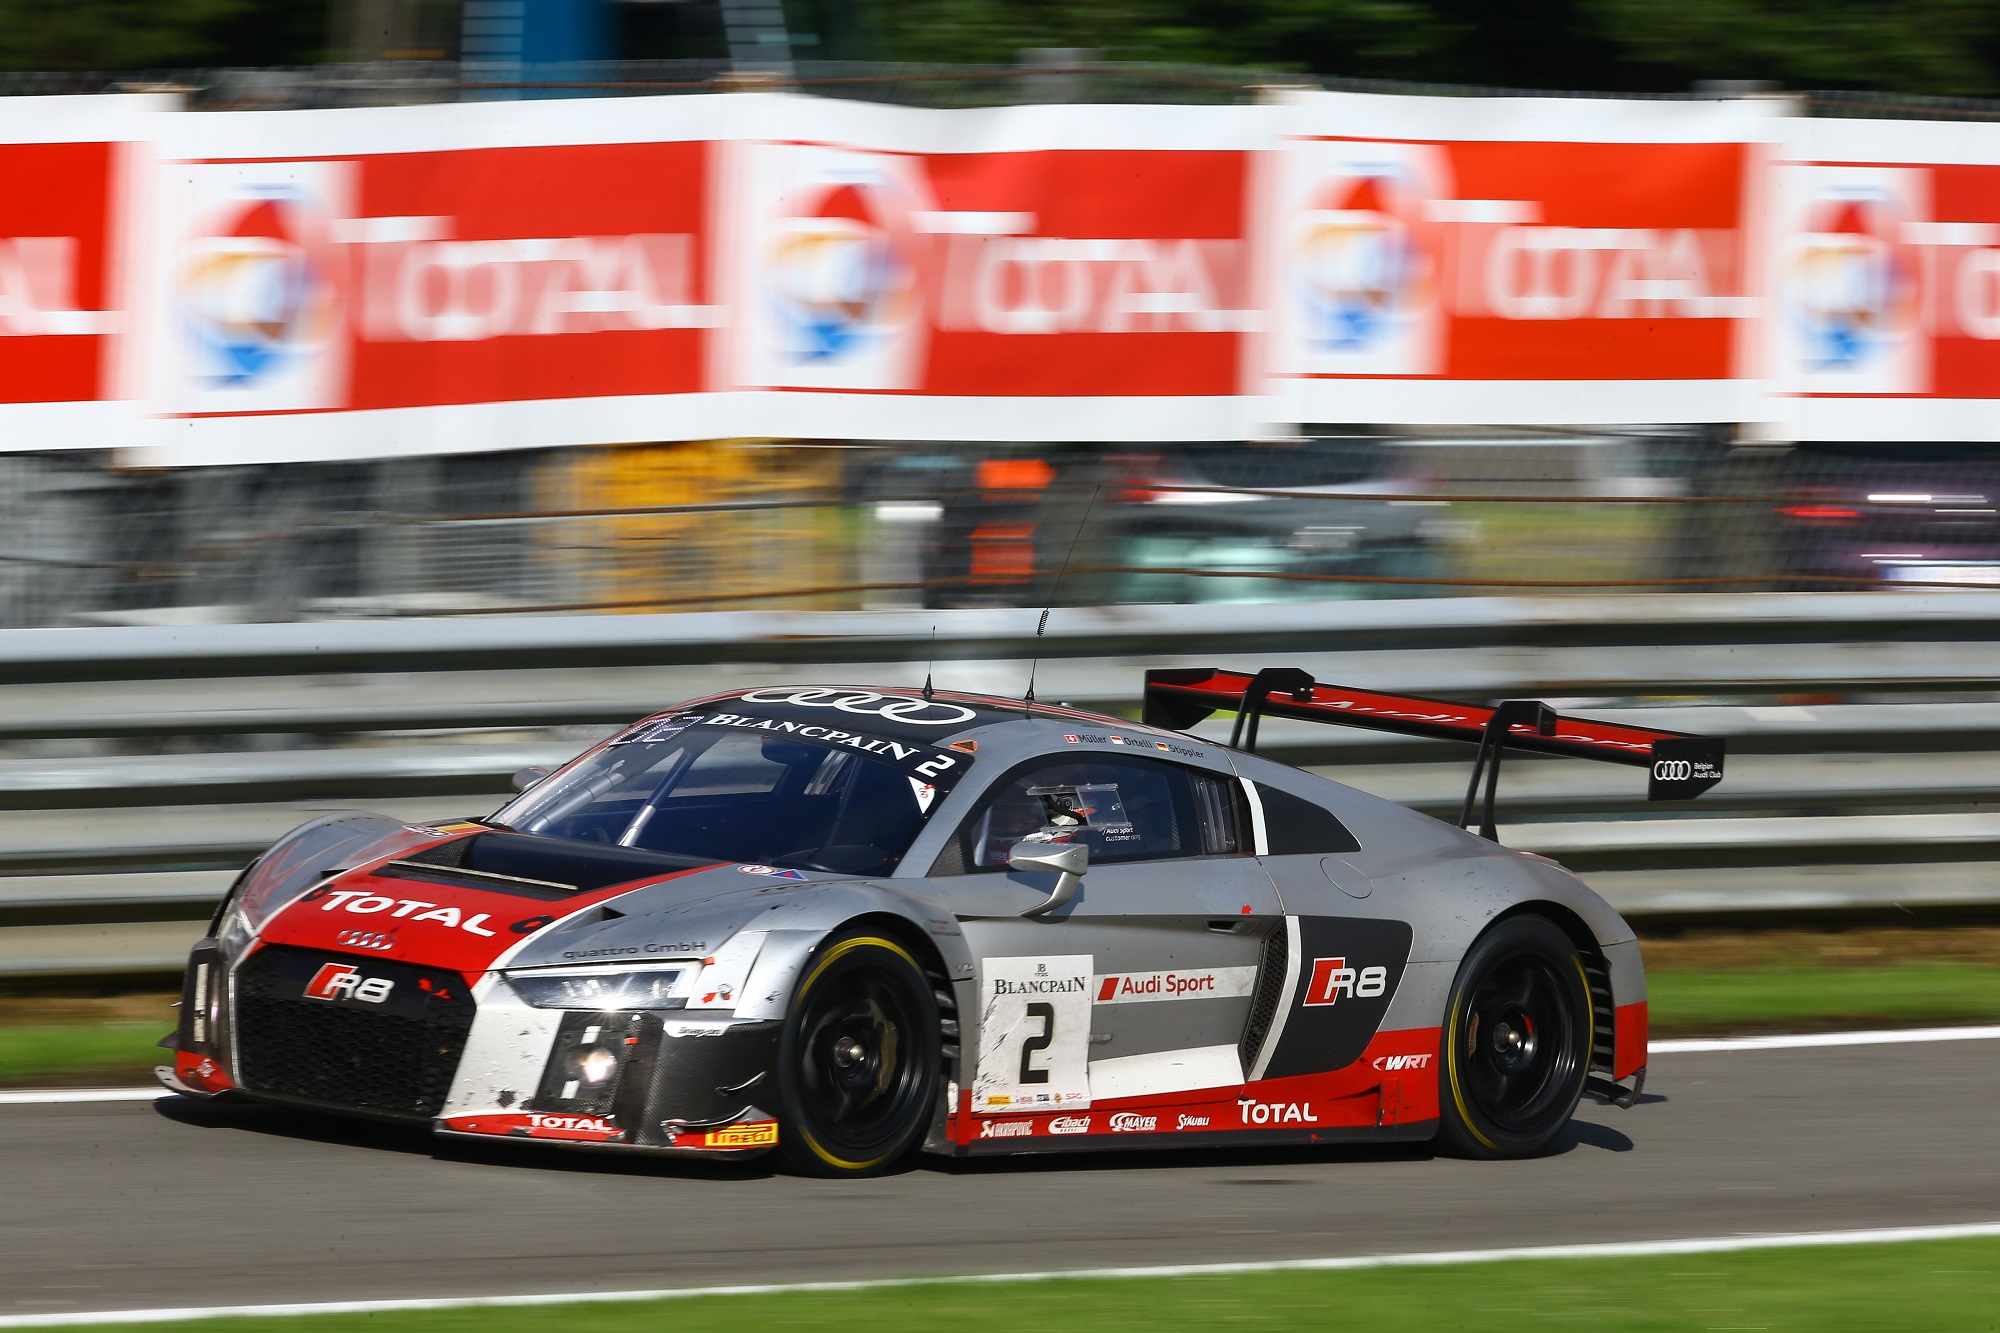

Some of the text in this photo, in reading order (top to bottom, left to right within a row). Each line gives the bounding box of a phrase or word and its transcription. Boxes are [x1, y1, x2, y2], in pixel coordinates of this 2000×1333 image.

[701, 713, 956, 778] BLANCPAIN 2
[1078, 734, 1205, 758] Müller Ortelli Stippler
[320, 890, 497, 938] TOTAL
[562, 940, 707, 960] quattro GmbH
[320, 971, 395, 1004] R8
[993, 976, 1086, 995] BLANCPAIN
[1121, 974, 1215, 997] Audi Sport
[1321, 964, 1387, 1000] R8
[1019, 1001, 1055, 1085] 2
[1385, 1053, 1433, 1070] WRT
[526, 1114, 613, 1131] TOTAL
[1122, 1116, 1157, 1128] MAYER
[1237, 1099, 1318, 1125] TOTAL
[1048, 1115, 1092, 1135] Eibach
